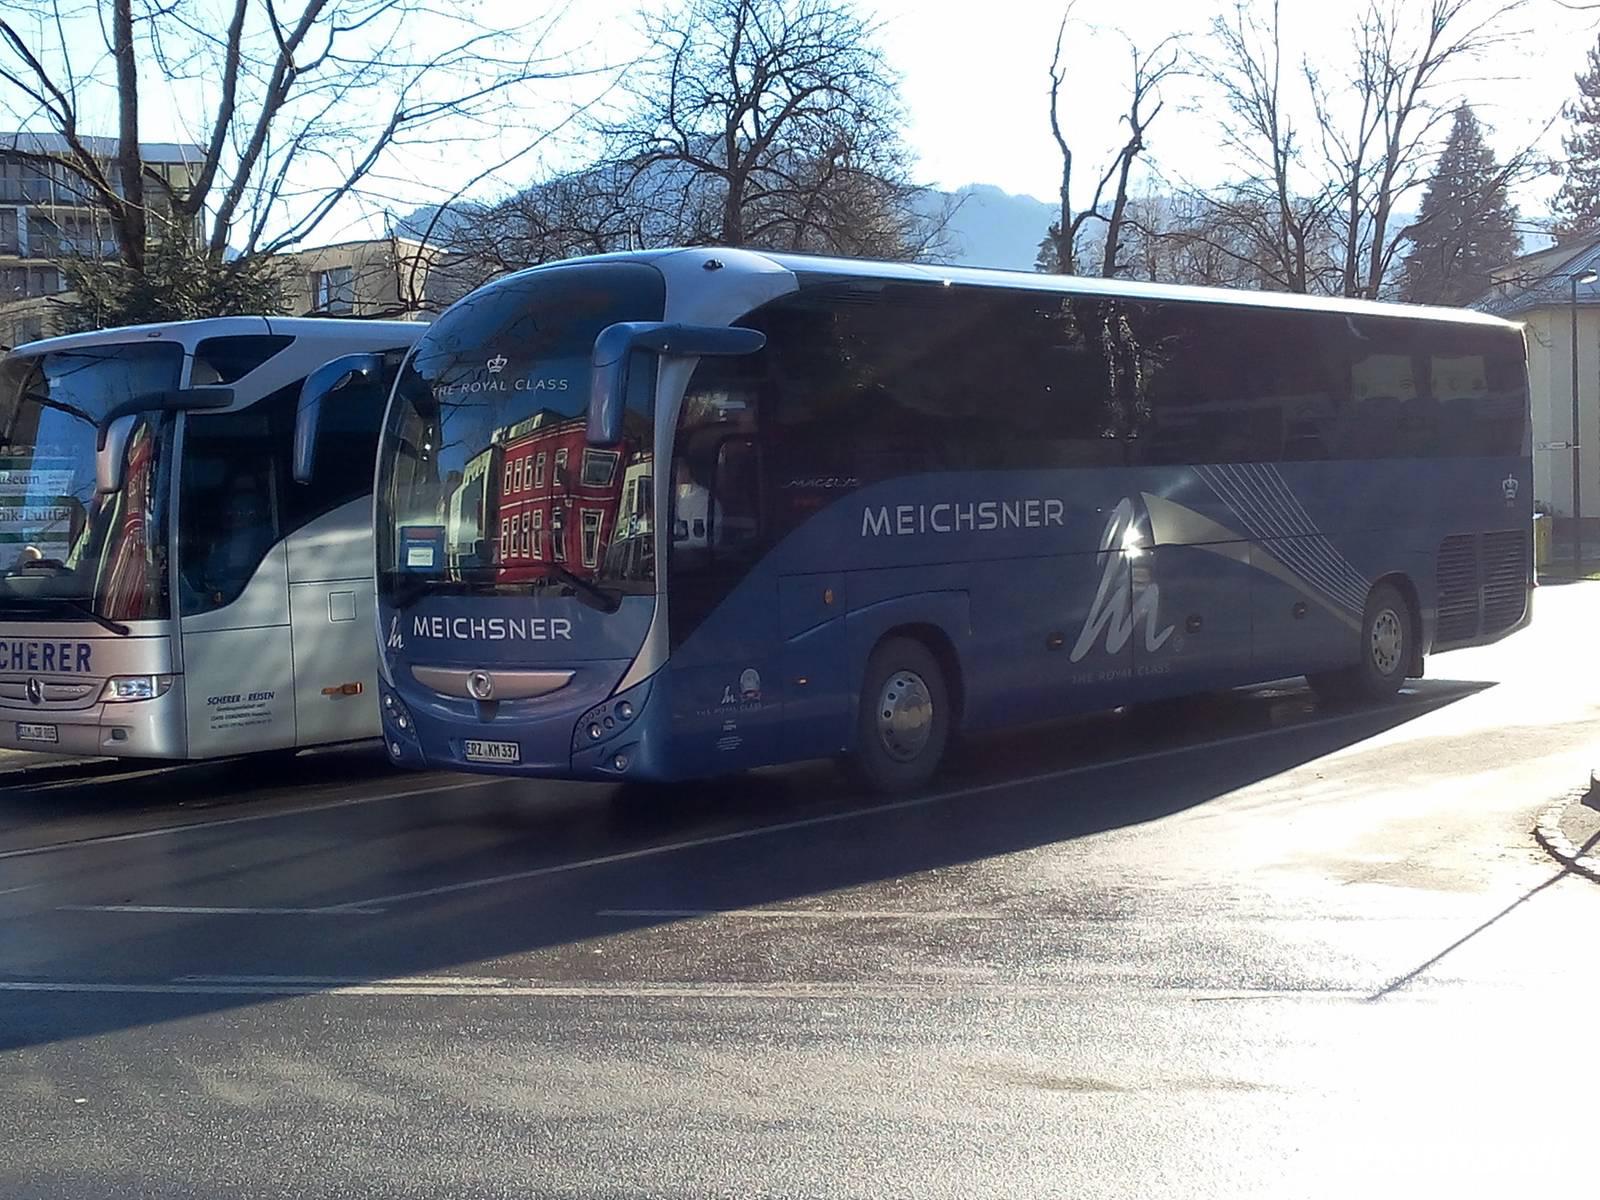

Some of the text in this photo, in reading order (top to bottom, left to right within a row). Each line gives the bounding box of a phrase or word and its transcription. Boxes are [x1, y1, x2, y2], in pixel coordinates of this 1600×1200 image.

[432, 379, 569, 397] THE ROYAL CLASS
[861, 498, 1064, 537] MEICHSNER
[413, 615, 572, 640] MEICHSNER
[0, 641, 92, 673] CHERER
[207, 694, 241, 706] SCHERER
[247, 691, 275, 702] REISEN
[466, 742, 517, 758] ERZ KM 337
